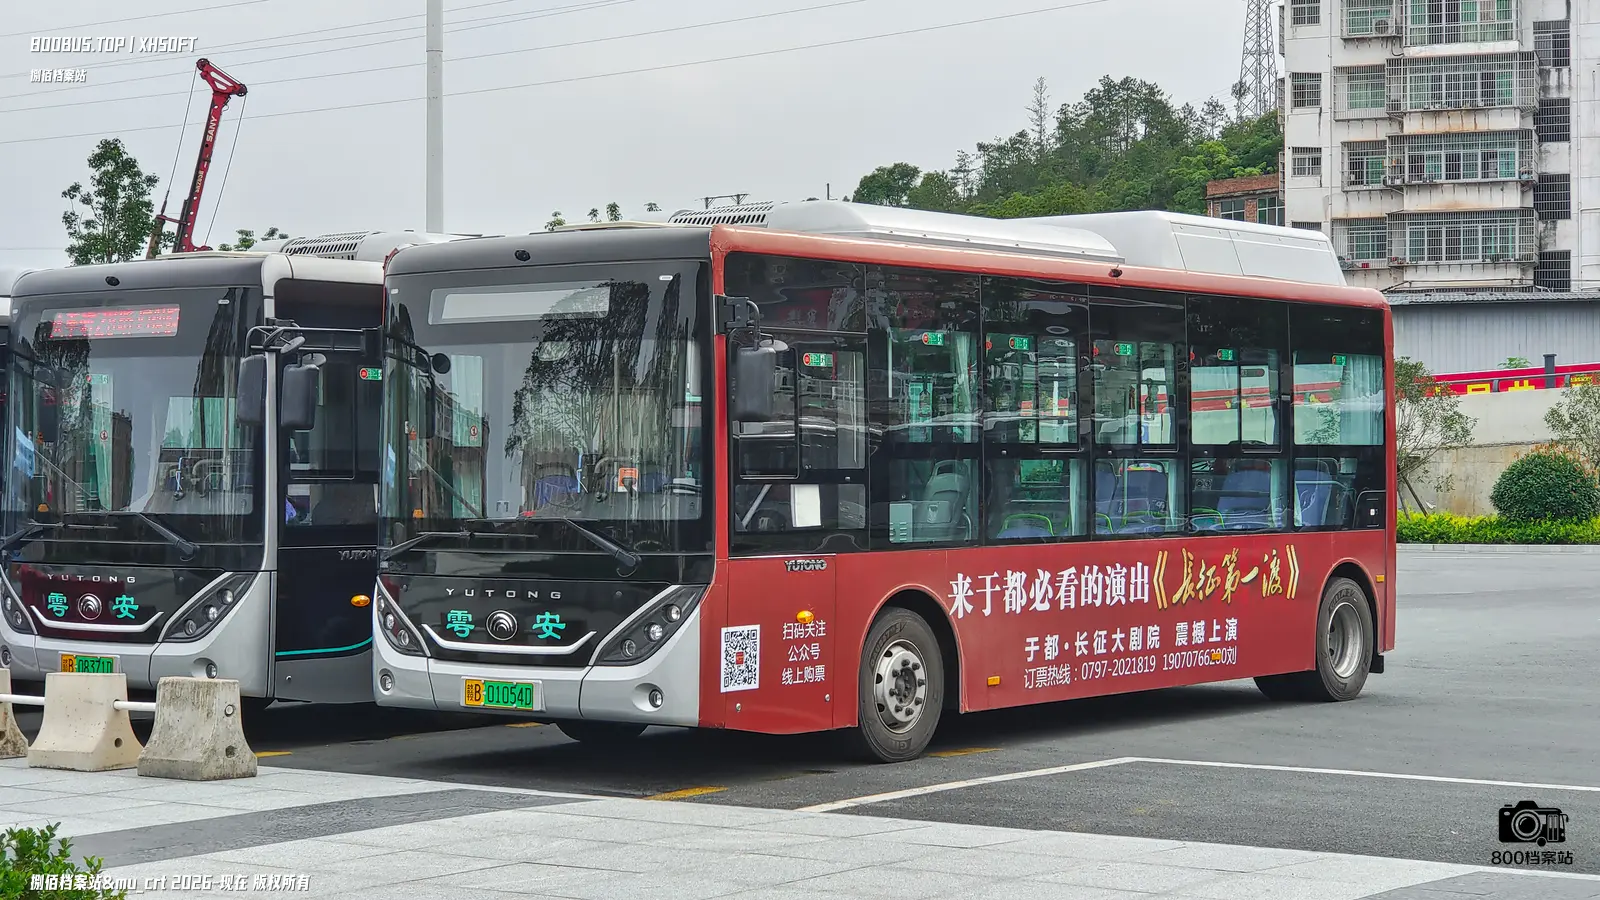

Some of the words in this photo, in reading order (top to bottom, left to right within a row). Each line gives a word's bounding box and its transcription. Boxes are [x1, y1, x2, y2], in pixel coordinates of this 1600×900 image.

[206, 115, 217, 142] SANY
[785, 559, 827, 571] YUTONG
[47, 573, 136, 583] YUTONG
[446, 588, 561, 599] YUTONG
[782, 619, 826, 640] 扫码关注
[1175, 617, 1238, 647] 震撼上演
[788, 642, 820, 662] 公众号
[781, 664, 825, 685] 线上购票
